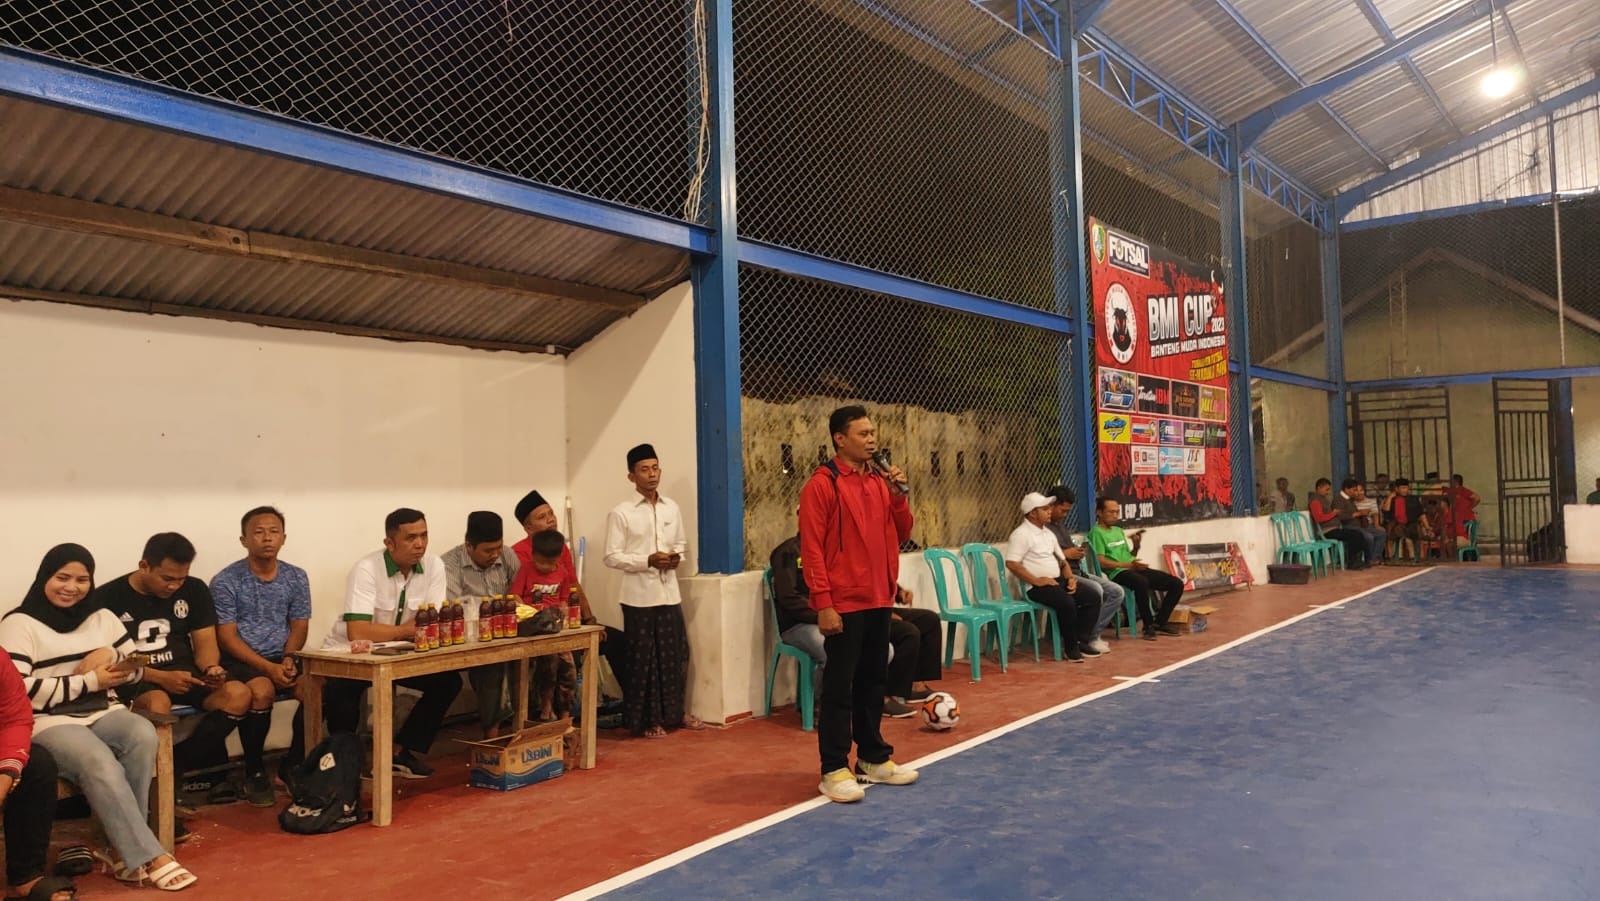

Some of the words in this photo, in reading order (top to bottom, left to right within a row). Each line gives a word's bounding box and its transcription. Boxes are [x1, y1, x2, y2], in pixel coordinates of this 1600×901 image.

[1109, 234, 1149, 269] FUTSAL
[1147, 296, 1180, 342] BMI
[1183, 294, 1213, 337] CUP
[1211, 317, 1225, 333] 2023
[1151, 341, 1180, 358] BANTENG
[1180, 339, 1198, 353] MUDA
